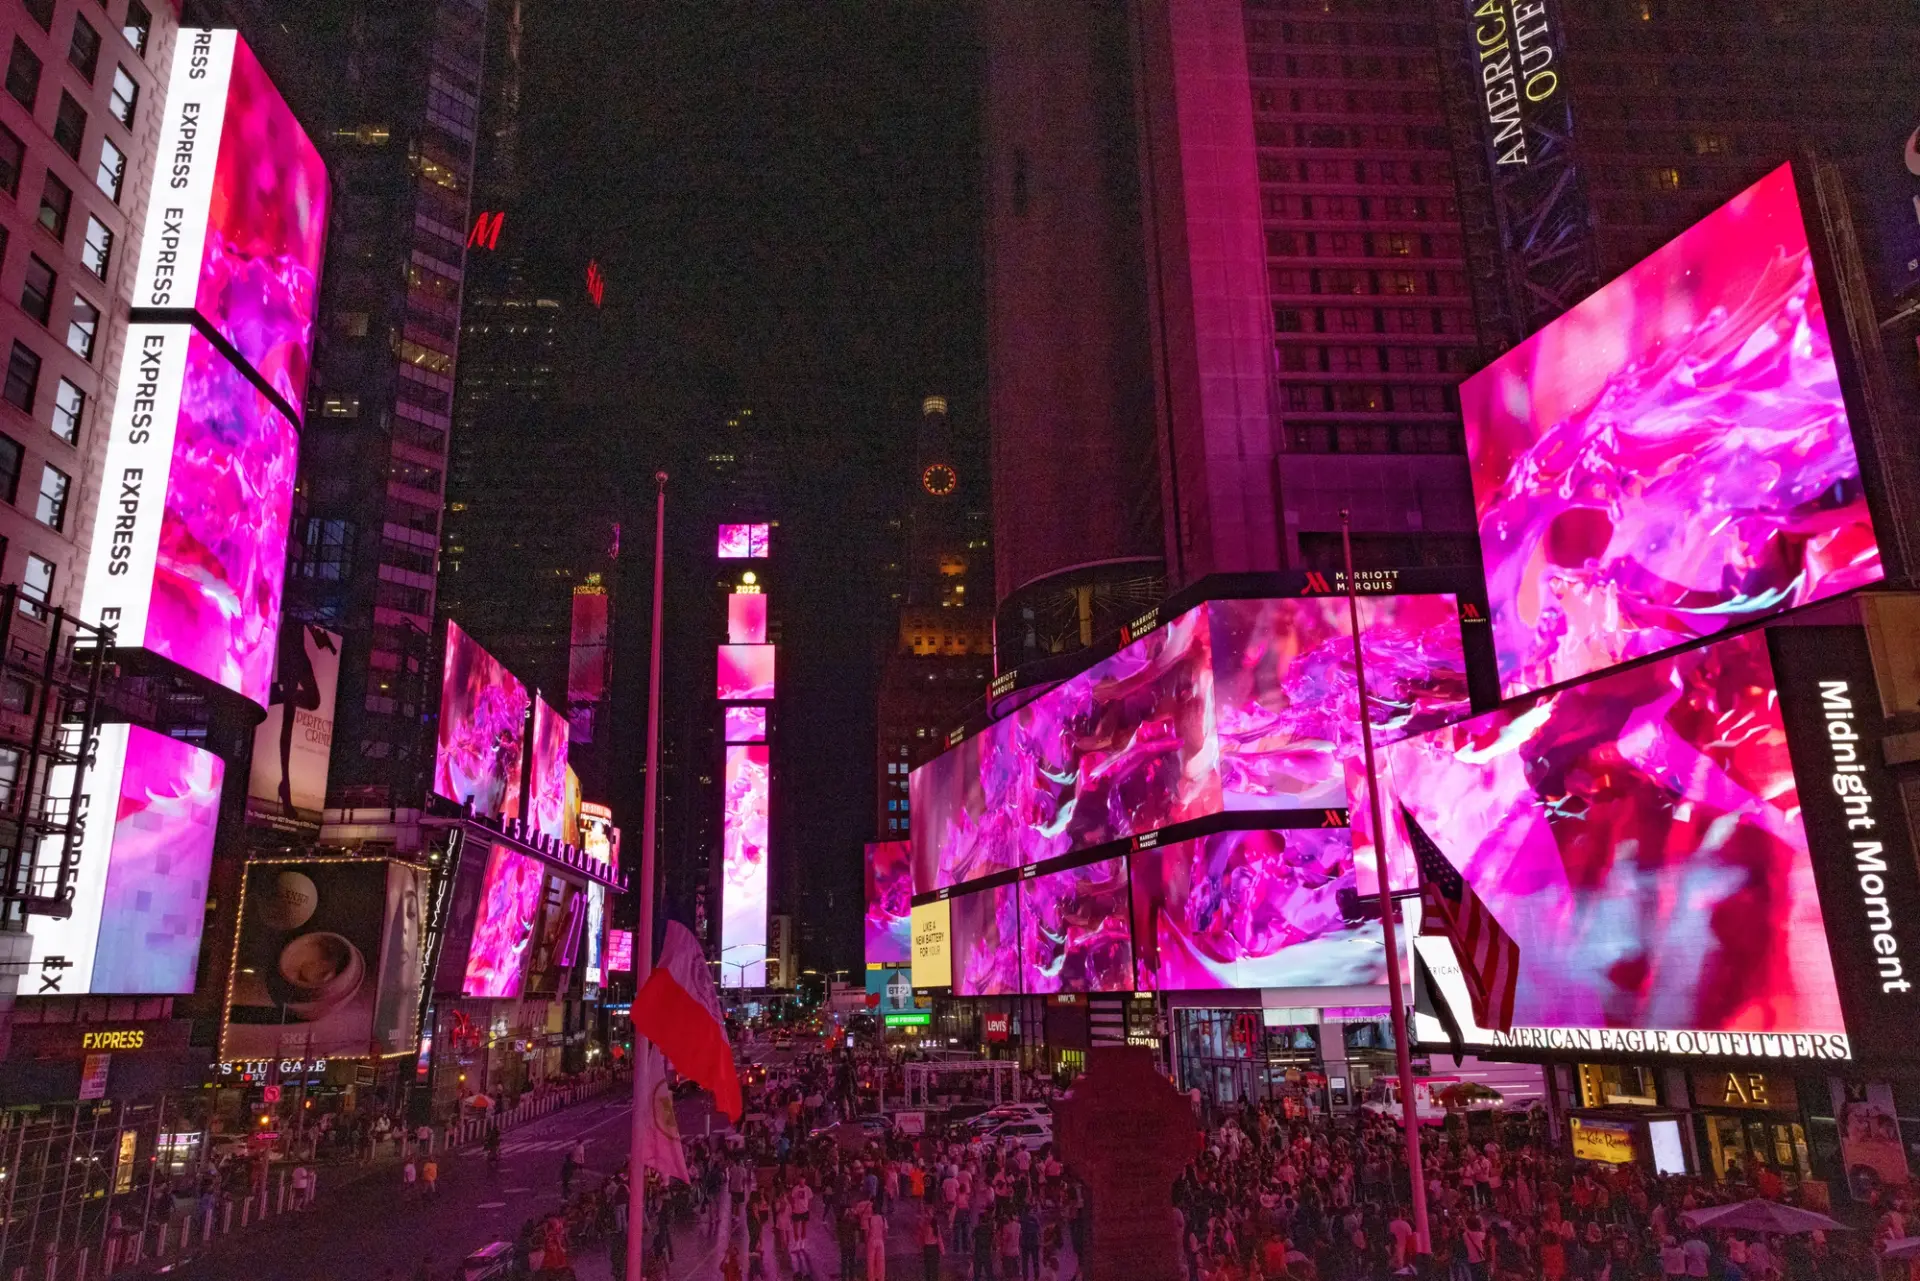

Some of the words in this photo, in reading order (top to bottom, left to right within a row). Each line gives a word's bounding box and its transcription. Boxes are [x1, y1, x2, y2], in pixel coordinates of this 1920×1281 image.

[1512, 0, 1557, 101] OUTF
[1474, 0, 1528, 165] AMERICA
[170, 102, 200, 189] EXPRESS
[150, 207, 183, 306] EXPRESS
[128, 335, 164, 445] EXPRESS
[107, 467, 143, 577] EXPRESS
[736, 585, 760, 594] 2022
[1131, 607, 1160, 629] MARRIOTT
[1132, 620, 1157, 639] MARQUIS
[502, 812, 544, 850] 1540
[547, 837, 619, 884] BROADWAY
[1818, 681, 1876, 832] Midnight
[1852, 841, 1912, 995] Moment
[922, 921, 932, 933] LIKE
[925, 931, 944, 944] BATTERY
[919, 947, 929, 957] FOR
[83, 1030, 145, 1049] EXPRESS
[1492, 1028, 1592, 1050] AMERICAN
[1600, 1030, 1670, 1052] EAGLE
[1676, 1032, 1849, 1060] OUTFITTERS
[246, 1060, 327, 1075] LUGAE
[1725, 1072, 1768, 1104] AE
